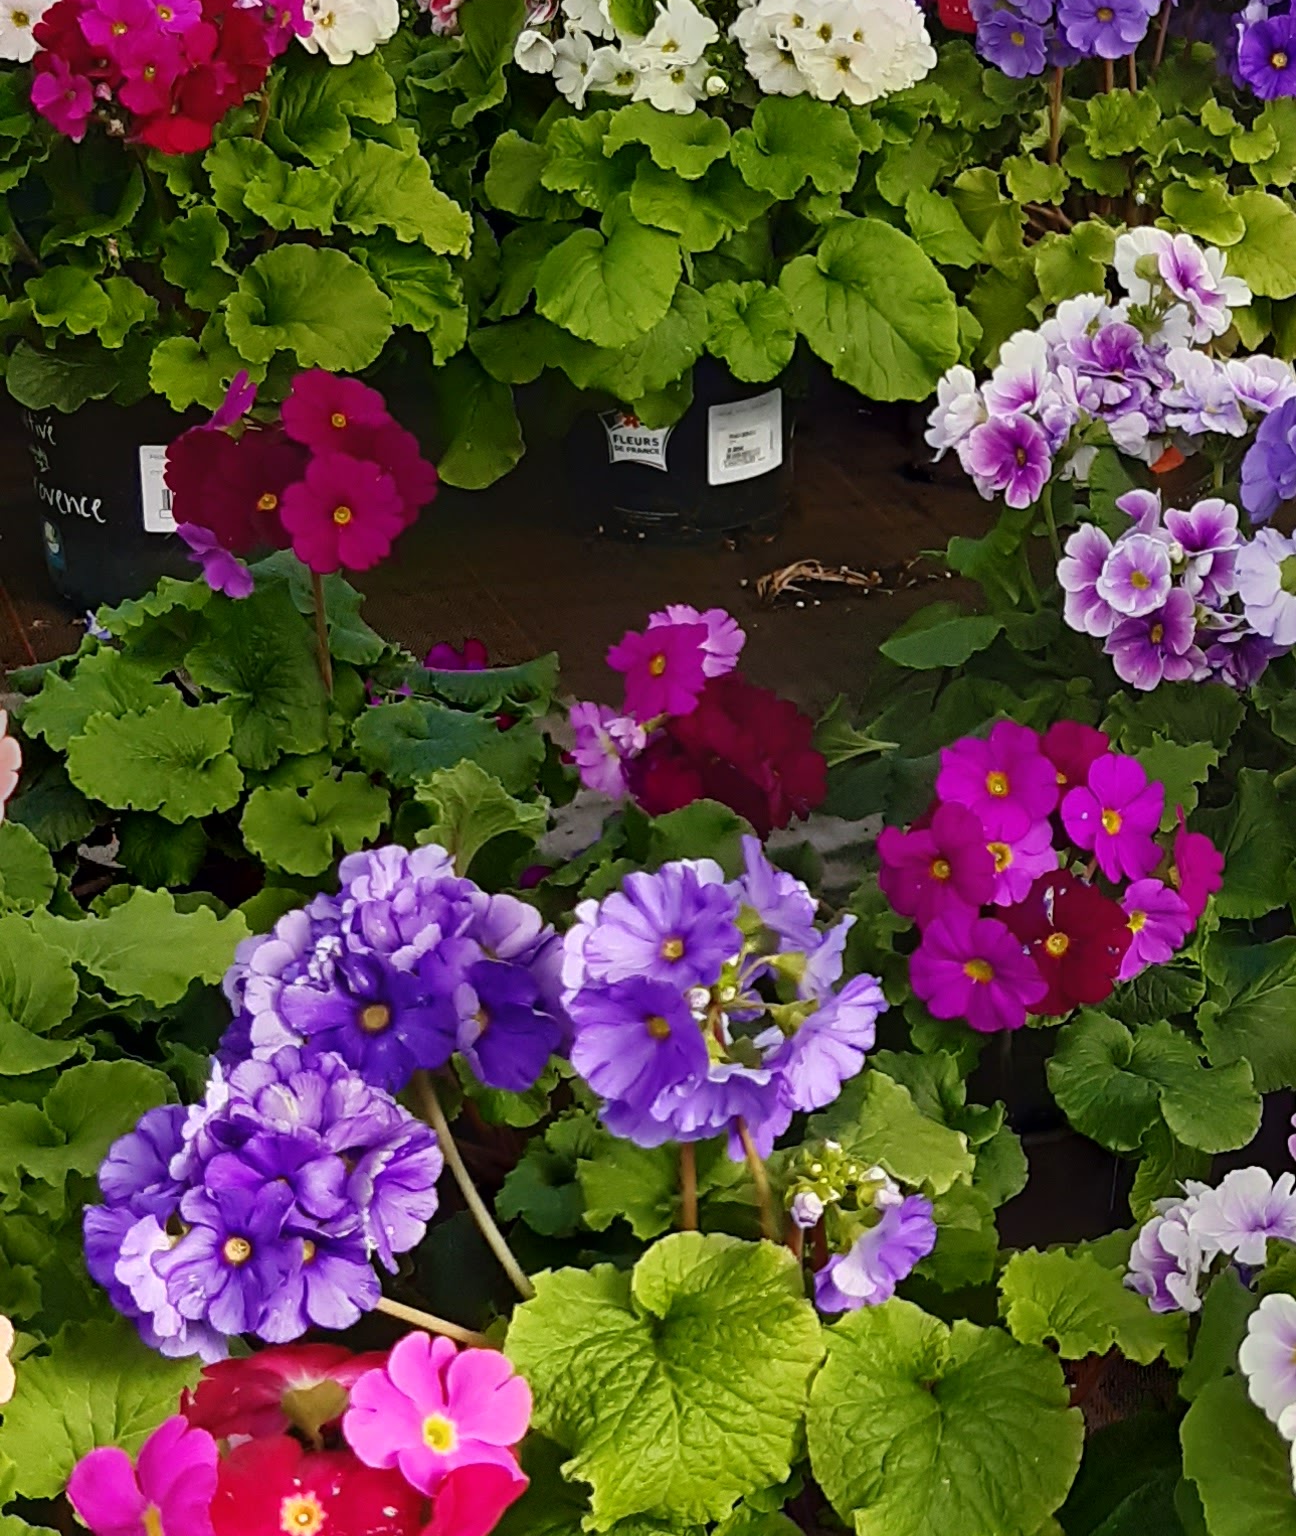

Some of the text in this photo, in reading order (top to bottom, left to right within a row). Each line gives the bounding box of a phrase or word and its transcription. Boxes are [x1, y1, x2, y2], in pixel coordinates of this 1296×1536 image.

[613, 433, 660, 447] FLEURS
[614, 444, 660, 455] DE FRANCE
